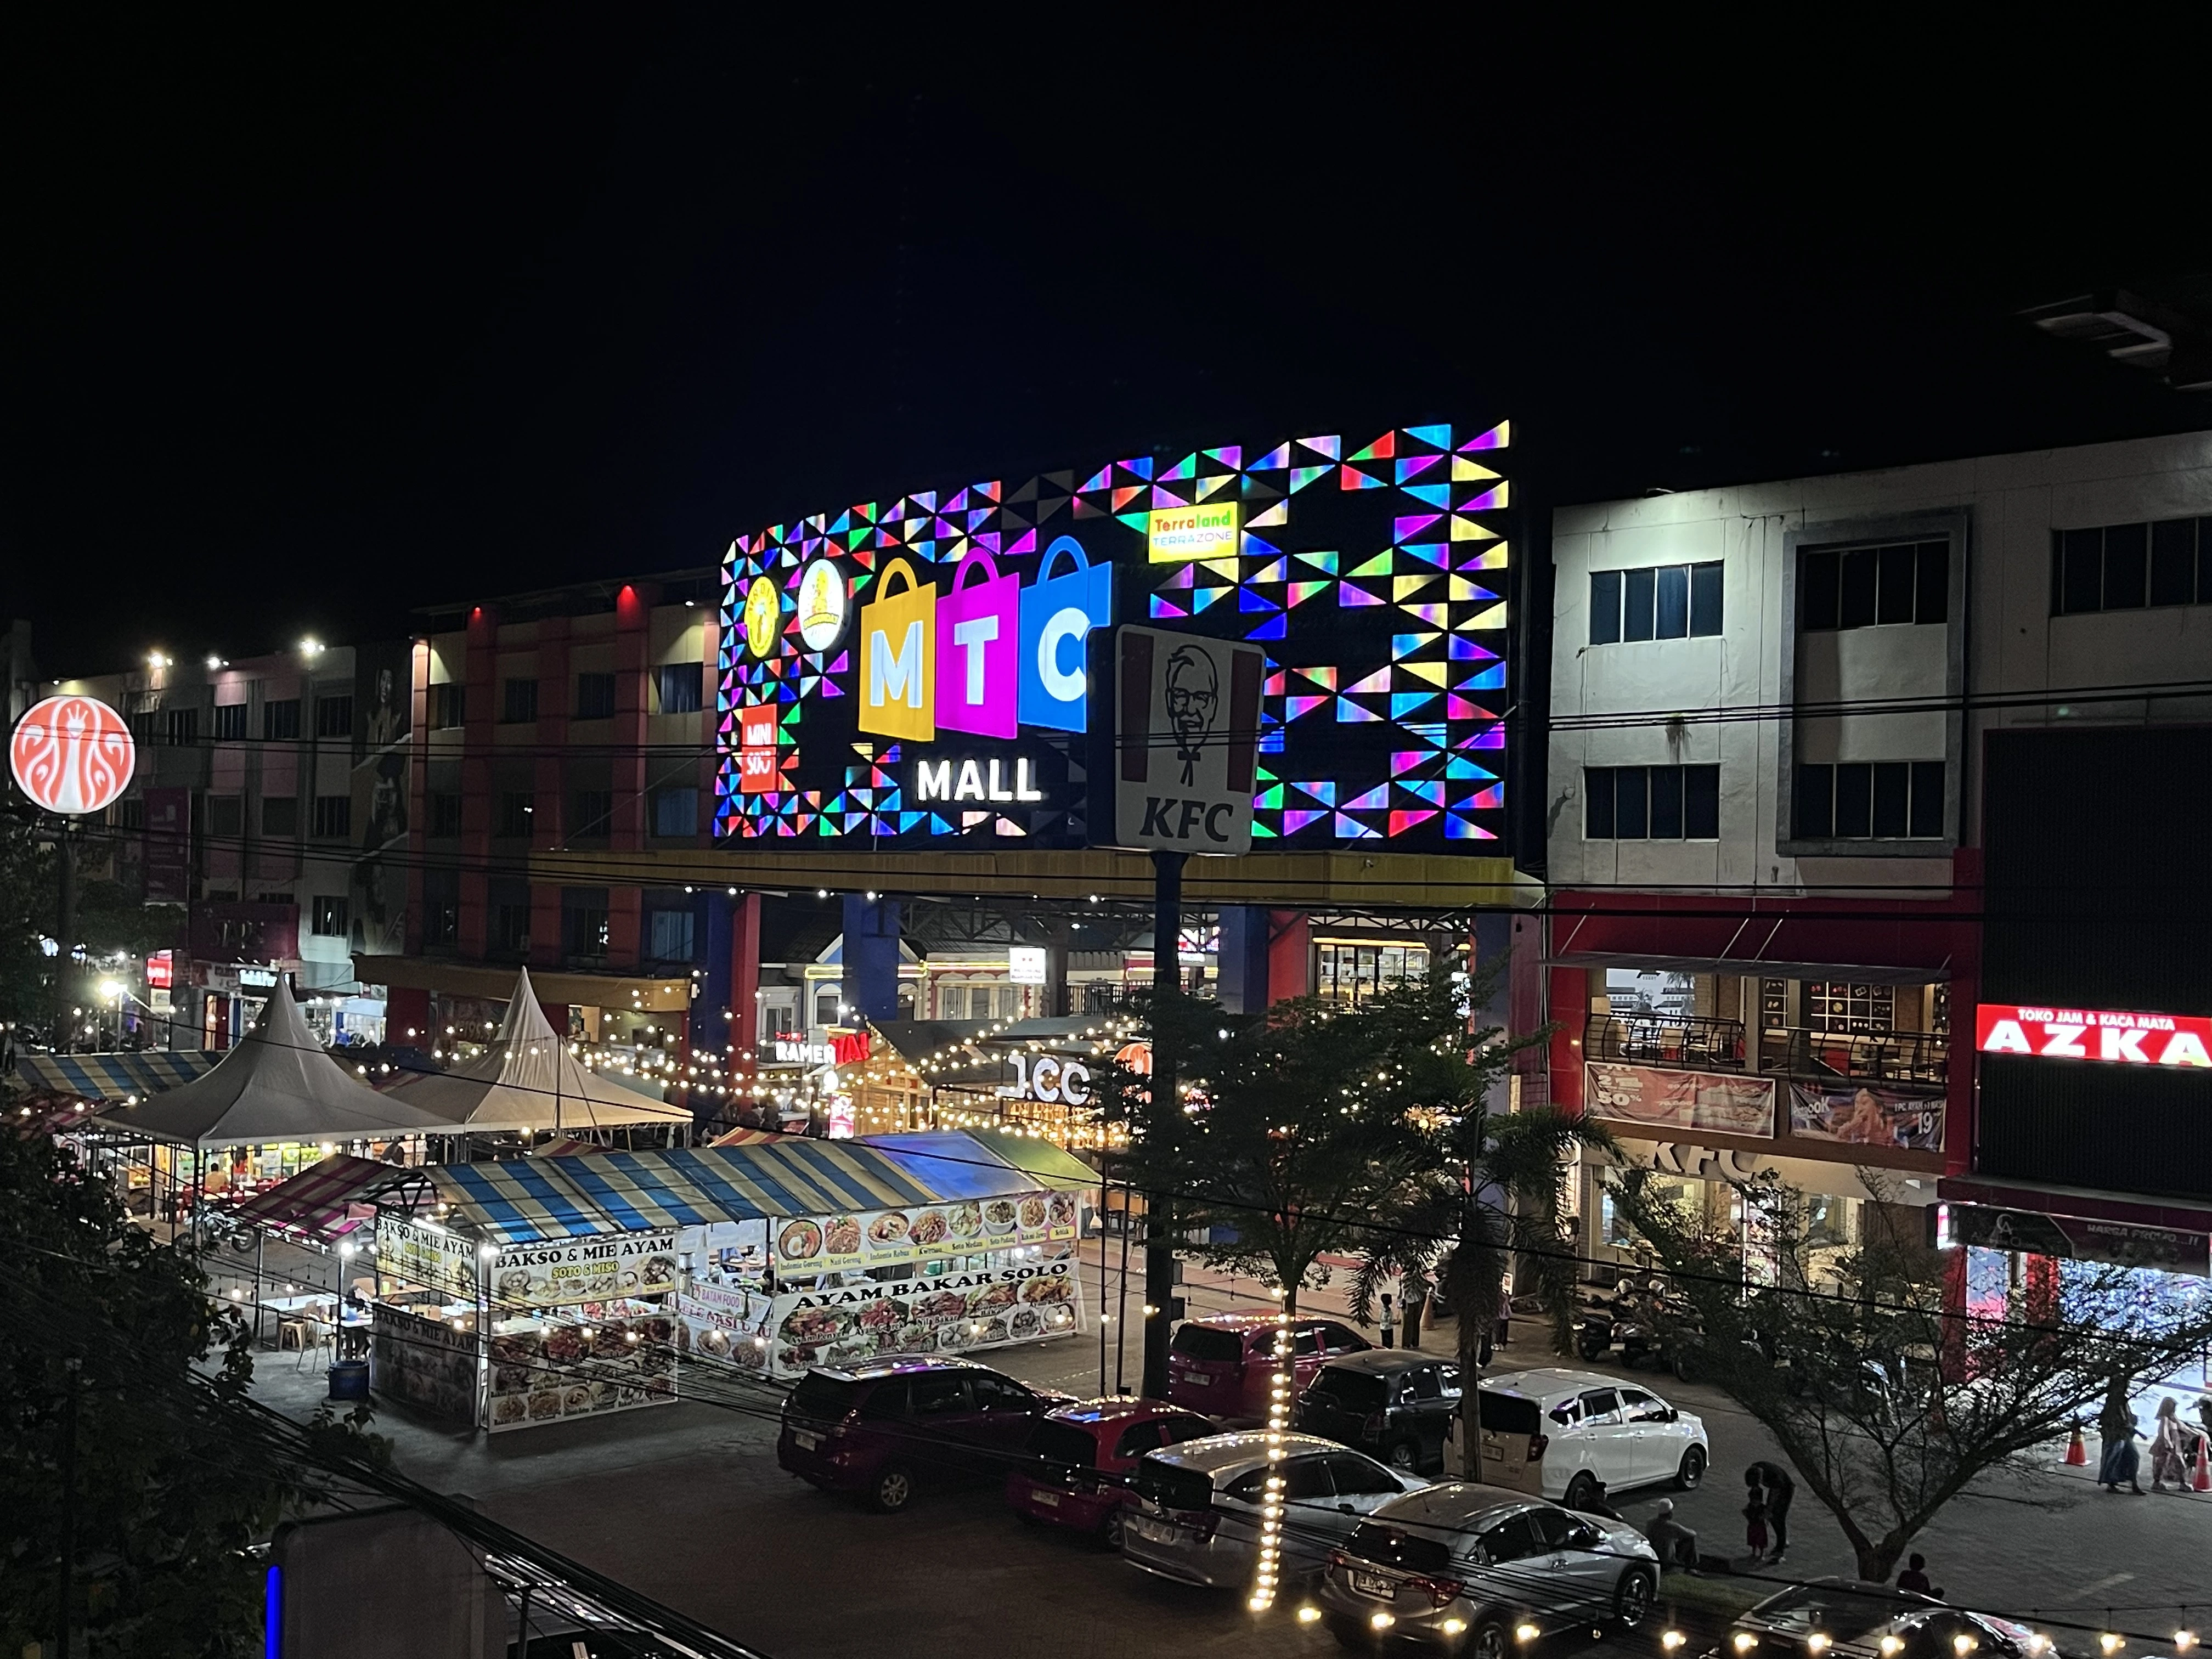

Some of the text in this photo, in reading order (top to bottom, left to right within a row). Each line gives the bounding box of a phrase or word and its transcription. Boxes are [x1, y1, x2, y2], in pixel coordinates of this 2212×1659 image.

[1155, 510, 1231, 532] Terraland
[1153, 531, 1233, 547] TERRAZONE
[917, 758, 1041, 801] MALL
[1139, 797, 1234, 842] KFC
[2018, 1008, 2176, 1030] TOKO JAM & KACA MATA
[775, 1042, 837, 1065] RAMEN
[1983, 1019, 2212, 1068] AZKA
[376, 1216, 410, 1240] BAKSO
[421, 1231, 441, 1249] MIE
[443, 1239, 475, 1260] AYAM
[494, 1237, 674, 1269] BAKSO & MIE AYAM
[551, 1265, 582, 1279] SOTO
[591, 1261, 620, 1276] MISO
[701, 1289, 723, 1305] BATAM
[723, 1295, 740, 1308] FOOD
[794, 1286, 883, 1310] AYAM
[891, 1272, 993, 1296] BAKAR
[1000, 1263, 1069, 1283] SOLO
